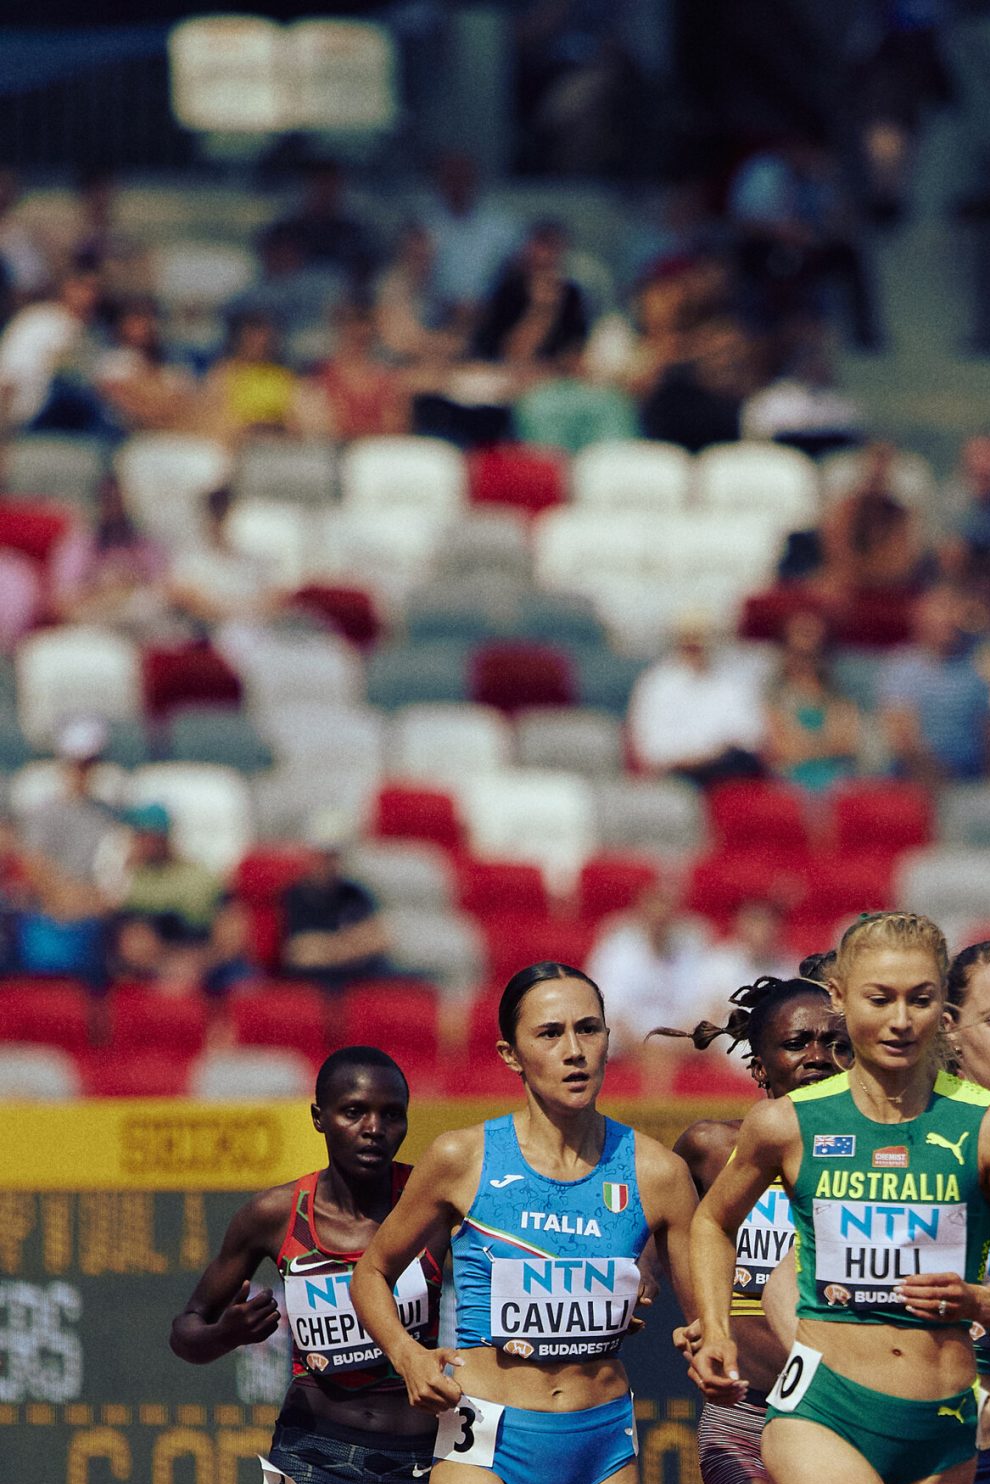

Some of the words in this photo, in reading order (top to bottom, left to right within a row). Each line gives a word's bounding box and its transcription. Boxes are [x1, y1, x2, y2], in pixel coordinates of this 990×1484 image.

[816, 1170, 960, 1201] AUSTRALIA
[520, 1211, 602, 1238] ITALIA
[840, 1204, 940, 1242] NTN
[523, 1260, 615, 1295] NTN
[855, 1290, 901, 1304] BUDA
[500, 1300, 629, 1334] CAVALLI
[453, 1406, 476, 1454] 3
